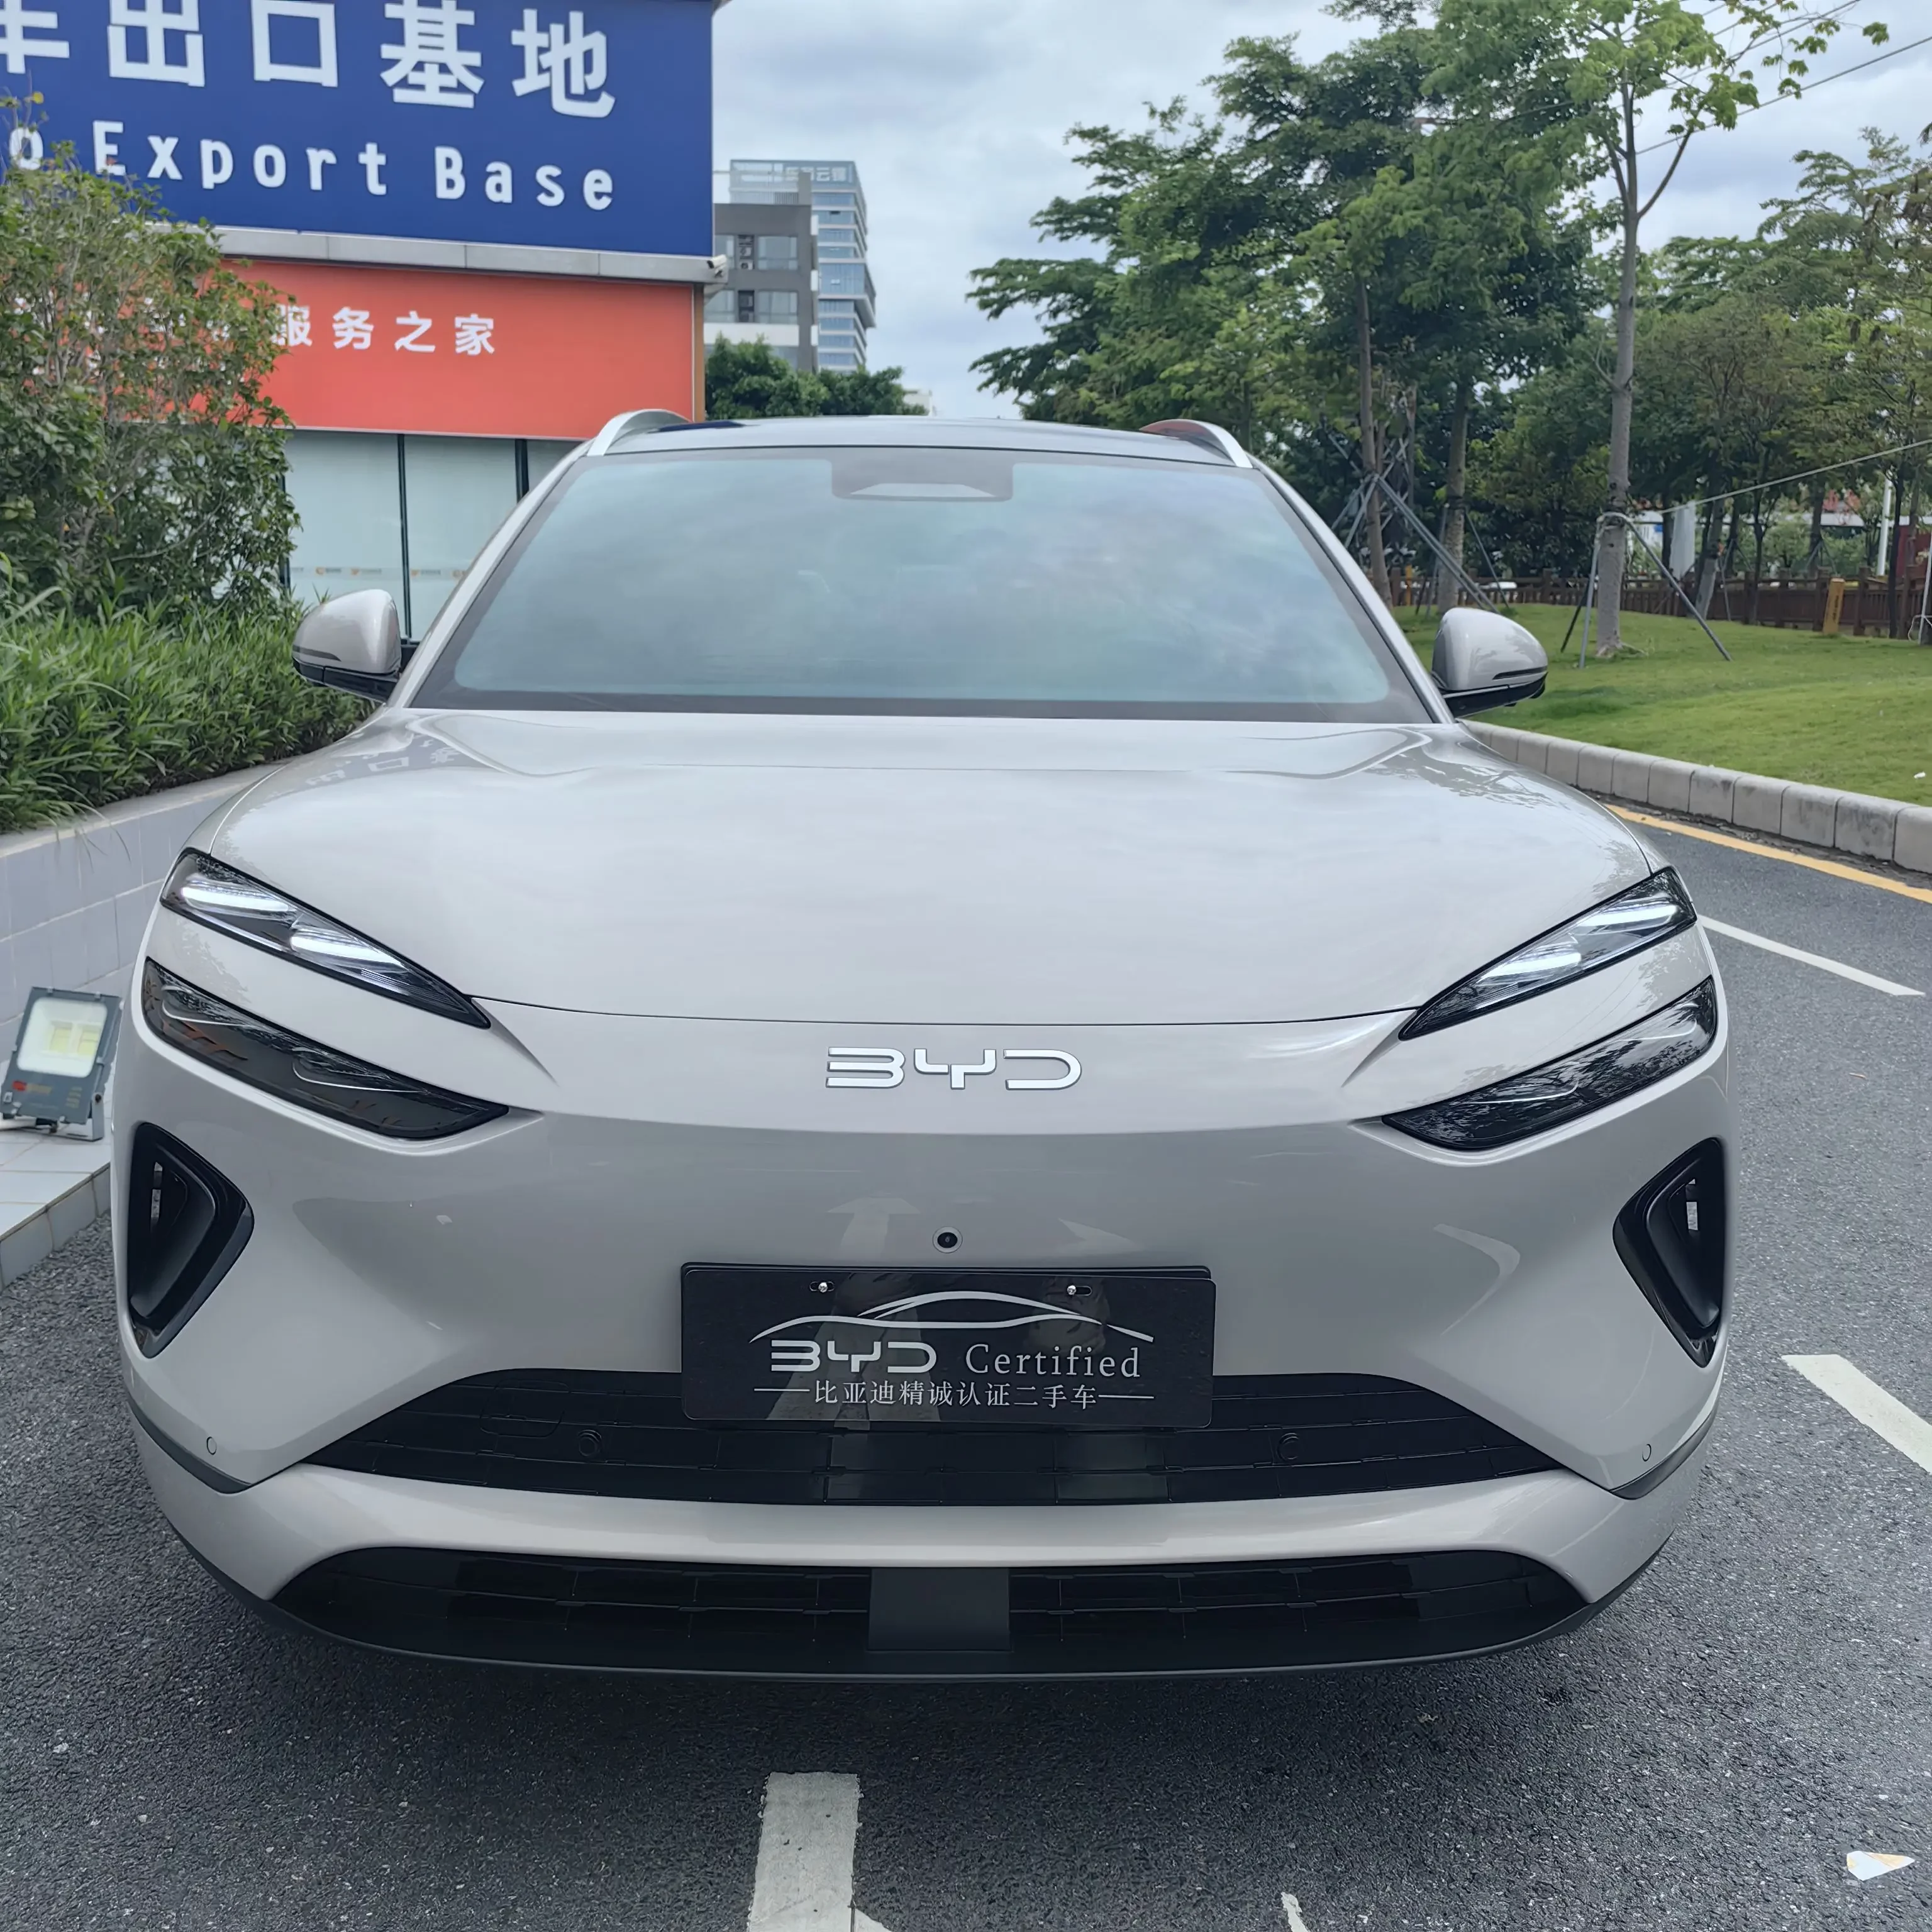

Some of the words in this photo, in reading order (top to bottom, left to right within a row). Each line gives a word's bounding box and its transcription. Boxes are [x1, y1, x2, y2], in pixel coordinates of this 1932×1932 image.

[93, 120, 386, 195] Export
[435, 147, 613, 210] Base
[826, 1046, 1082, 1091] BYD
[771, 1340, 936, 1373] BYD
[965, 1343, 1140, 1377] Certified
[815, 1380, 1096, 1409] 比亚迪精诚认证二手车
